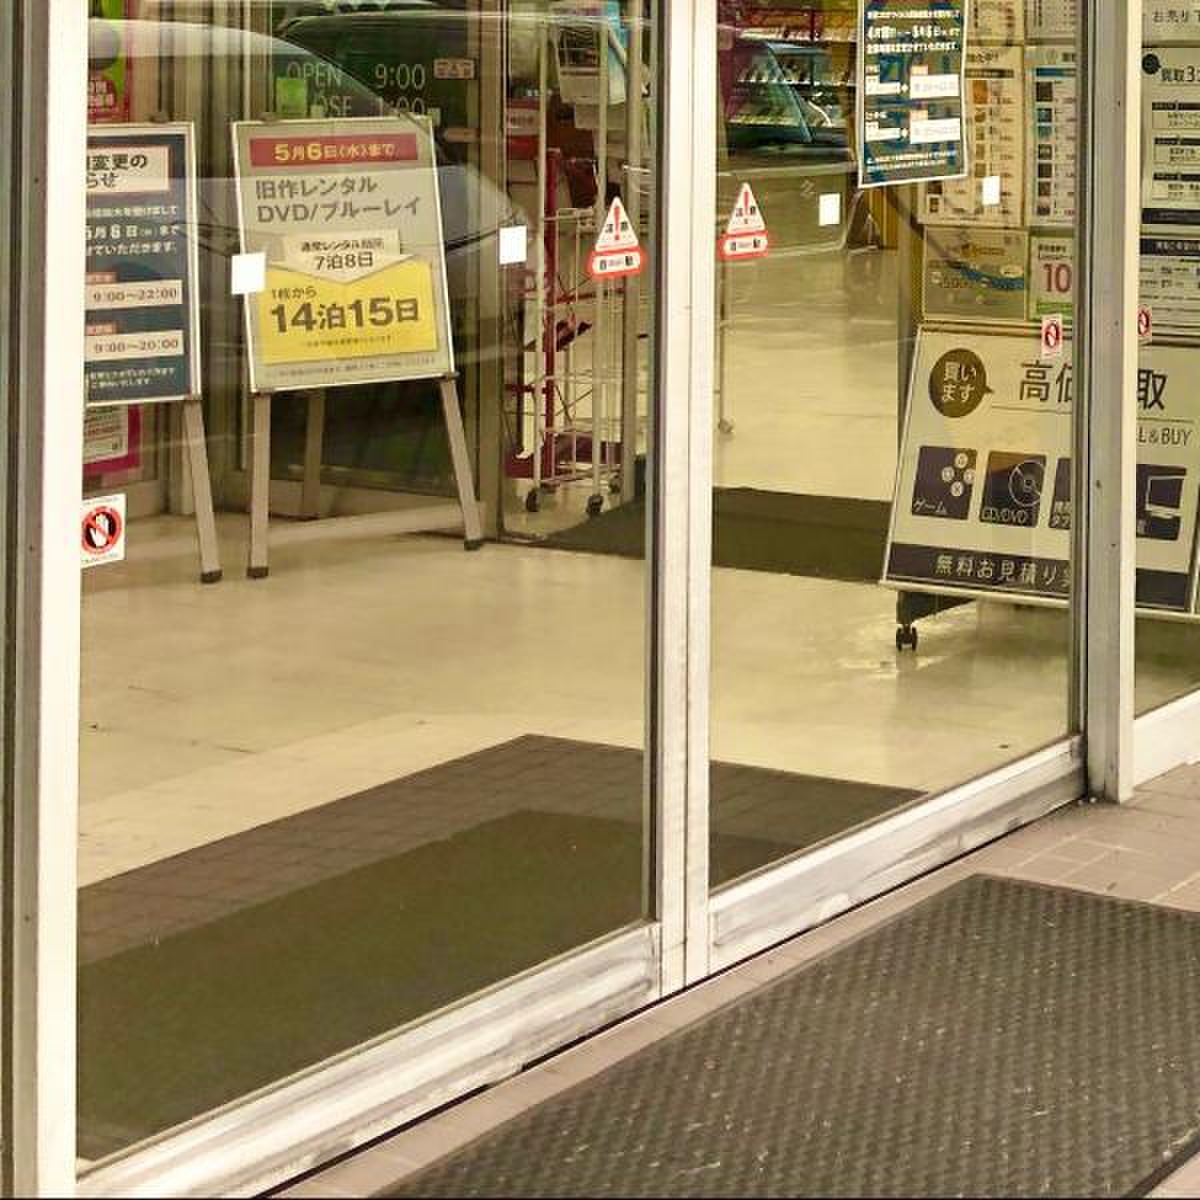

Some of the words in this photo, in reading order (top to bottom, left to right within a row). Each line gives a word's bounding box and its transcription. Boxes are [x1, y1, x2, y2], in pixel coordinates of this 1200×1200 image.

[374, 63, 426, 91] 9:00
[86, 153, 148, 171] 変更の
[256, 176, 378, 200] 旧作レンタル
[257, 197, 420, 223] DVD/ブルーレイ
[314, 252, 374, 270] 7泊8日
[270, 298, 420, 333] 14泊15日
[913, 497, 949, 514] ゲーム
